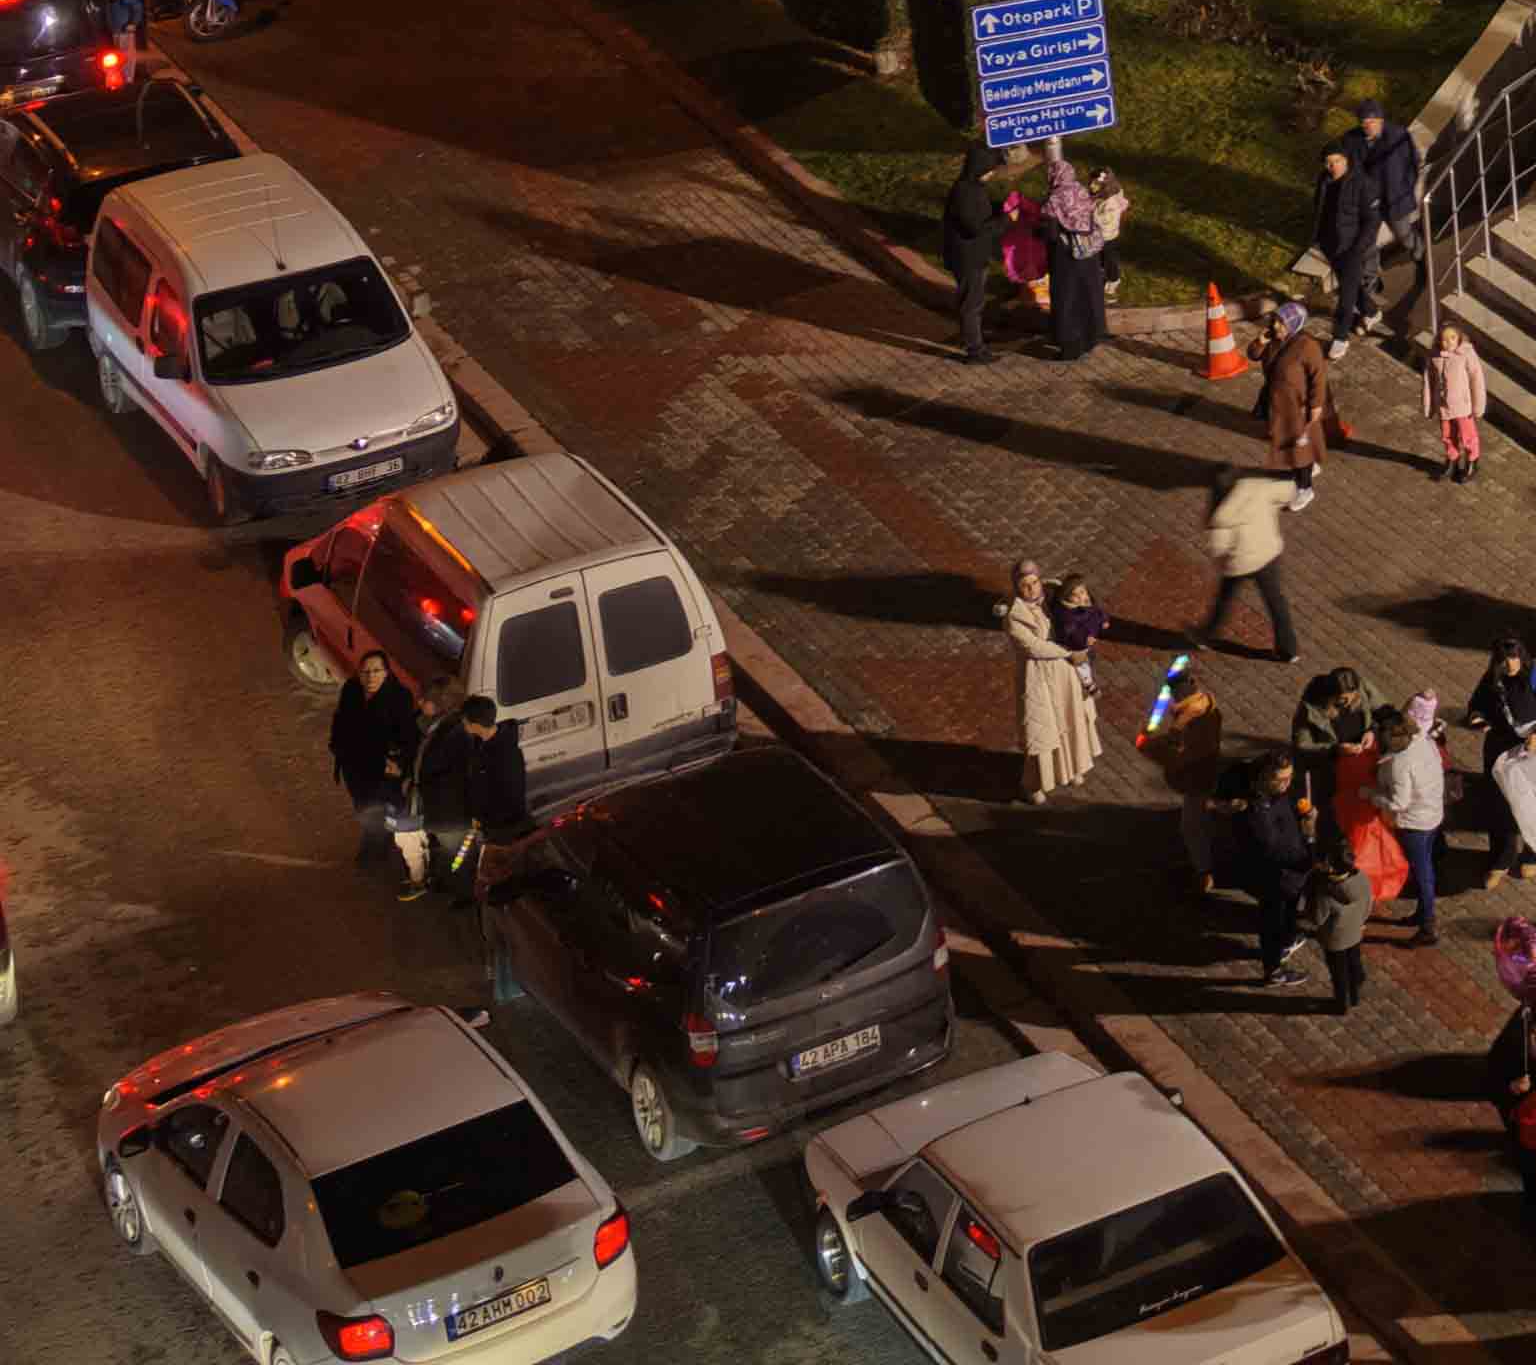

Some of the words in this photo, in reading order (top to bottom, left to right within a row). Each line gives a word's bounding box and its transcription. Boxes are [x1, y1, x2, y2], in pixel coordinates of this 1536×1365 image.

[1002, 3, 1073, 26] Otopark
[982, 52, 1028, 67] Yaya
[1030, 38, 1078, 58] Girişi
[985, 84, 1033, 103] Belediye
[1034, 74, 1082, 95] Meydanı
[989, 113, 1039, 131] Sekine
[1040, 105, 1085, 121] Hatun
[457, 1310, 480, 1330] 42
[481, 1297, 514, 1324] AHM
